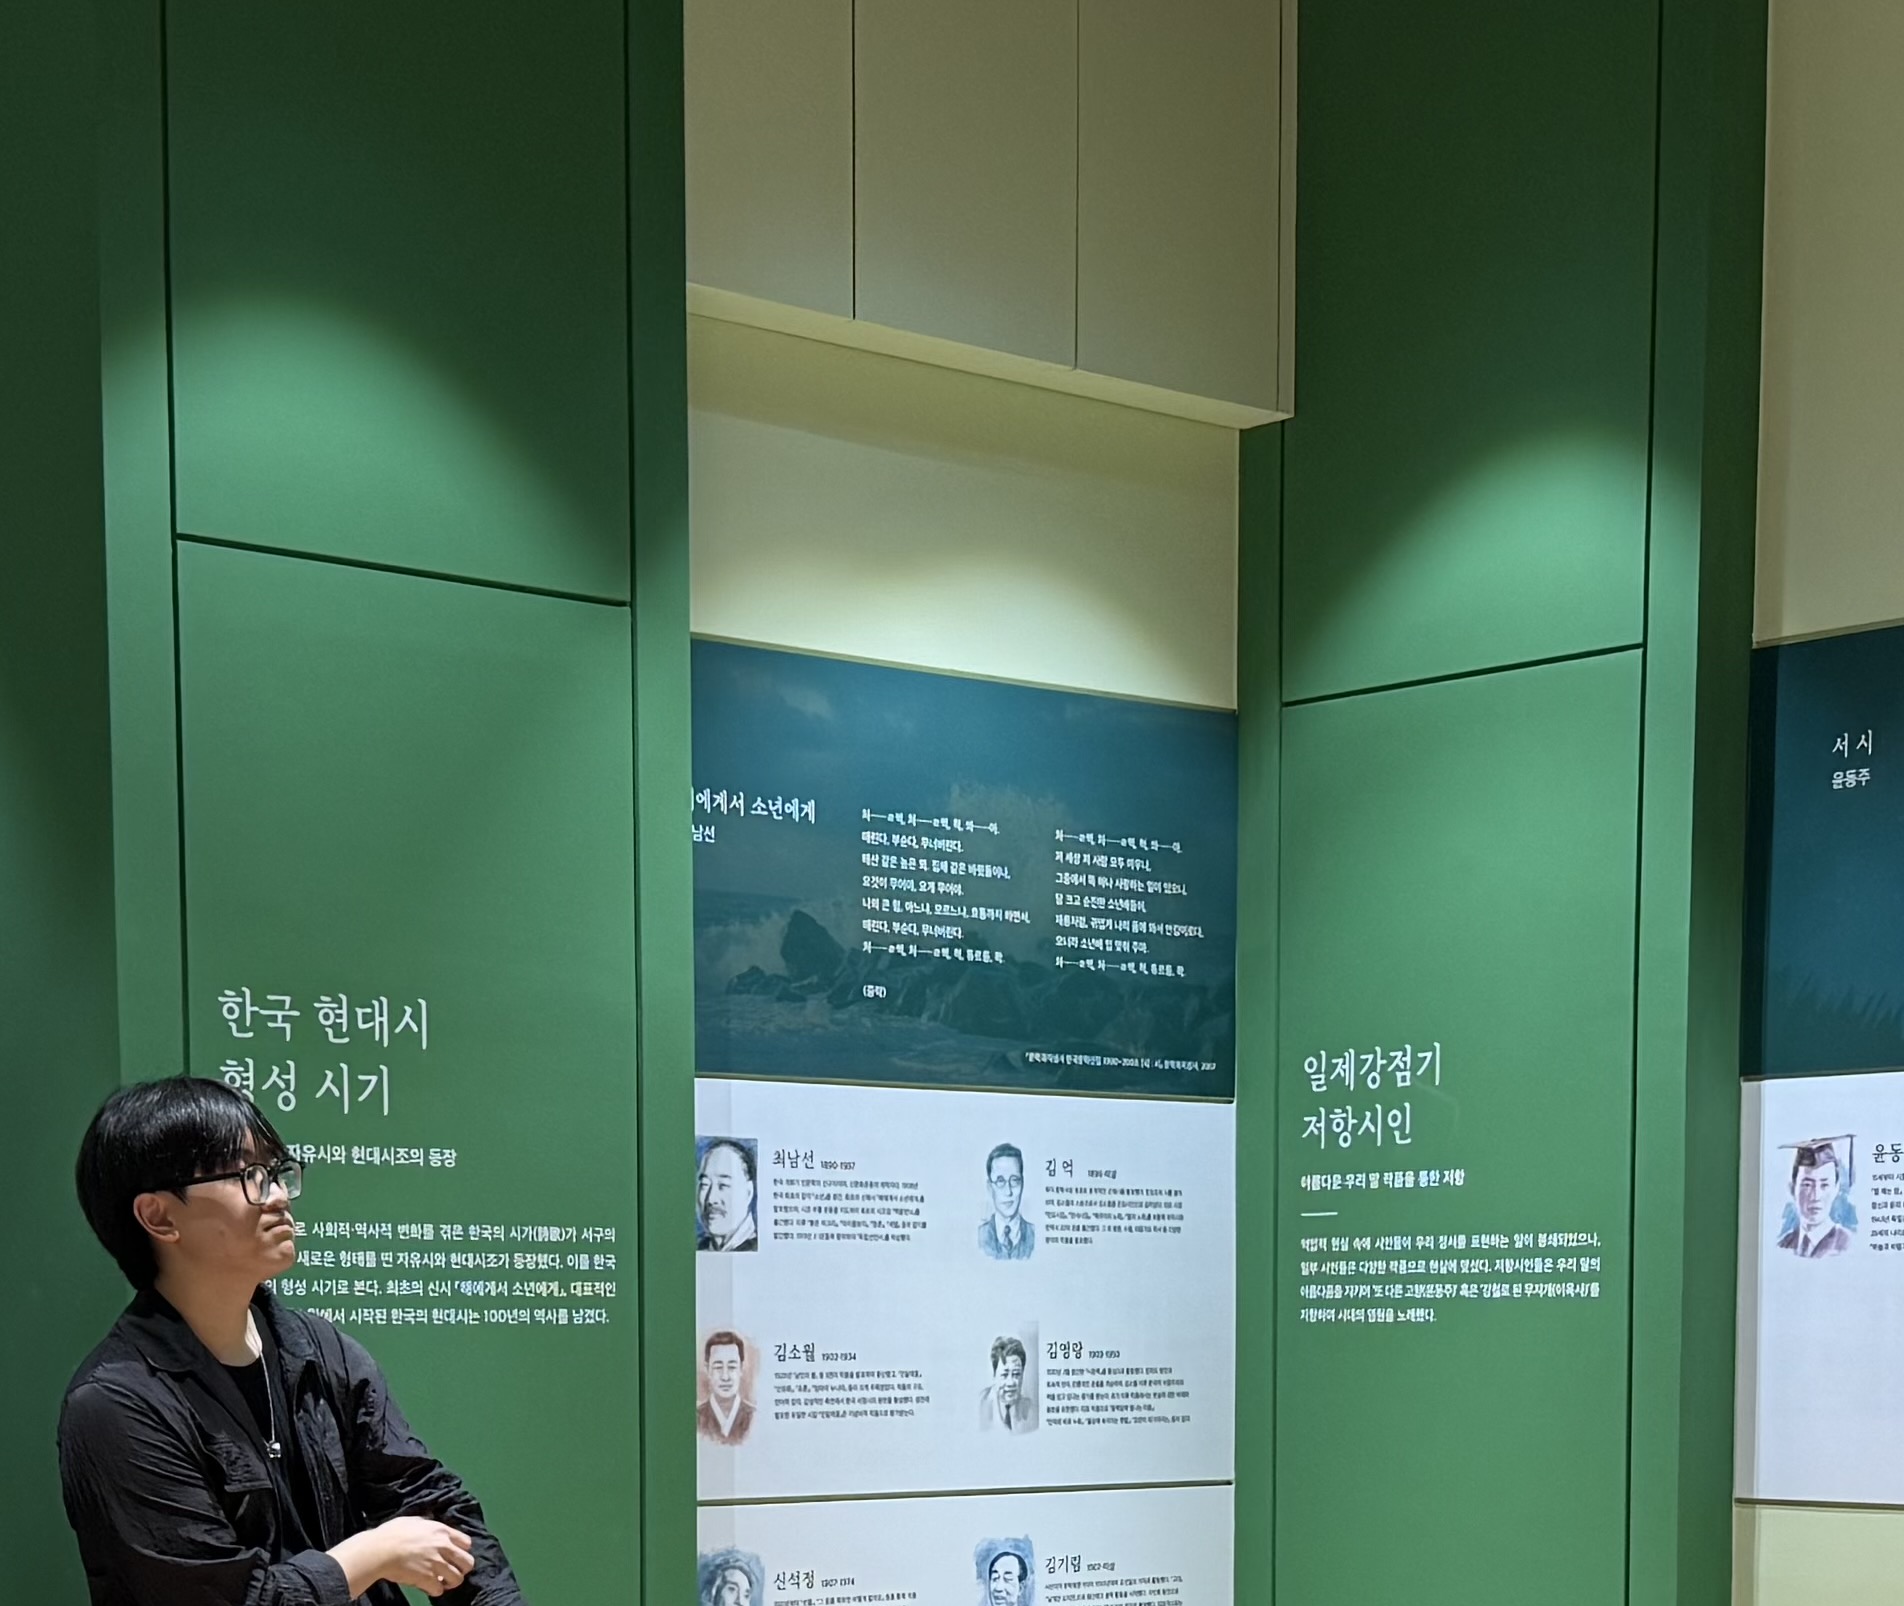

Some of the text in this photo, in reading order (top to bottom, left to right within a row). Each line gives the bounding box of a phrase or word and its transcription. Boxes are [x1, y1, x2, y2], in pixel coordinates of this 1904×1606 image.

[1832, 729, 1873, 758] 서 시
[1831, 767, 1872, 790] 윤동주
[692, 789, 815, 825] 에게서 소년에게
[692, 825, 716, 844] 남선
[218, 986, 430, 1052] 한국 현대시
[1303, 1042, 1441, 1093] 일제강점기
[220, 1056, 392, 1118] 형성 시기
[1302, 1102, 1413, 1149] 저항시인
[287, 1143, 457, 1167] 자유시와 현대시조의 등장
[772, 1148, 815, 1170] 최남선
[1046, 1158, 1056, 1177] 김
[312, 1222, 392, 1240] 사회적·역사적
[398, 1223, 434, 1240] 변화를
[440, 1224, 463, 1240] 겪은
[469, 1225, 504, 1242] 한국의
[582, 1226, 615, 1243] 서구의
[297, 1250, 616, 1270] 새로운 형태를 띤 자유시와 현대시조가 등장했다. 이를 한국
[282, 1279, 306, 1296] 형성
[312, 1279, 349, 1296] 시기로
[354, 1279, 382, 1296] 본다.
[387, 1279, 423, 1296] 최초의
[428, 1279, 451, 1297] 신시
[571, 1281, 615, 1297] 대표적인
[350, 1308, 386, 1324] 시작된
[391, 1308, 427, 1324] 한국의
[432, 1308, 480, 1324] 현대시는
[484, 1308, 530, 1324] 100년의
[534, 1309, 568, 1324] 역사를
[572, 1309, 609, 1324] 남겼다.
[774, 1342, 815, 1362] 김소월
[1046, 1341, 1083, 1360] 김영랑
[1045, 1554, 1081, 1574] 김기림
[774, 1570, 814, 1590] 신석정
